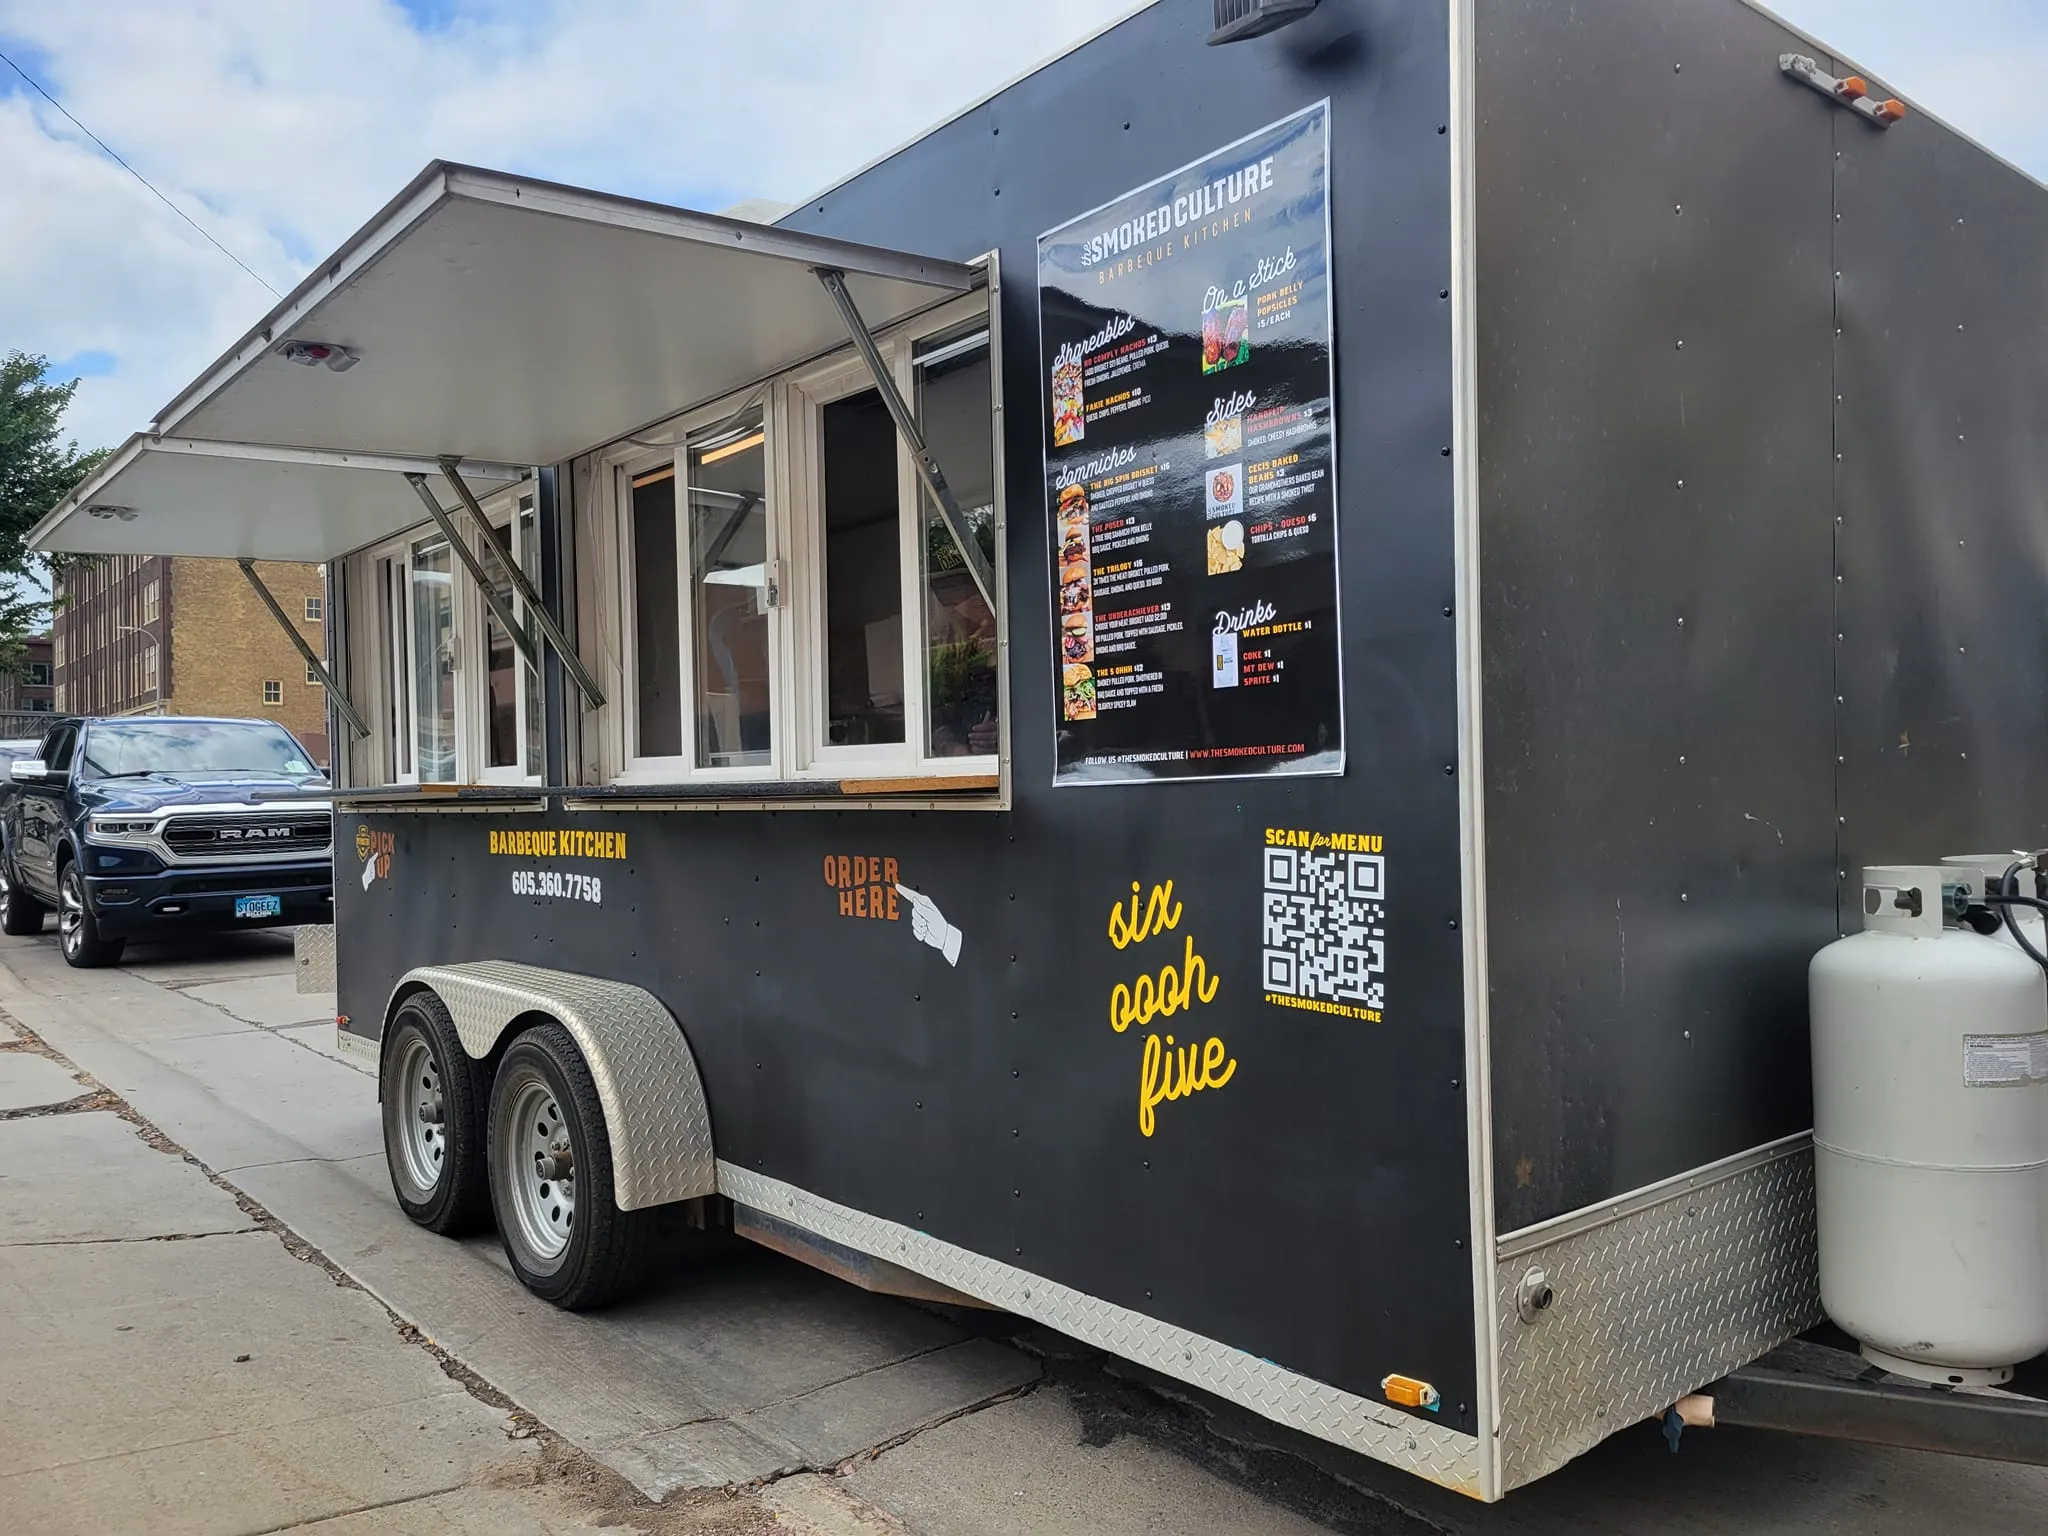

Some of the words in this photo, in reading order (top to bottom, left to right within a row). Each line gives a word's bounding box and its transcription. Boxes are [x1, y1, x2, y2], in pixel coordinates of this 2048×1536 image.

[1091, 205, 1171, 263] SMOKED
[1174, 156, 1274, 228] CULTURE
[1099, 241, 1173, 285] BARBEQUE
[1184, 207, 1251, 249] KITCHEN
[1201, 285, 1228, 315] On
[1233, 279, 1246, 298] a
[1248, 245, 1297, 291] Stick
[1256, 290, 1277, 306] PORK
[1279, 280, 1304, 297] BELLY
[1256, 295, 1298, 318] POPSICLES
[1256, 309, 1291, 329] $5/EACH
[1054, 314, 1136, 368] Shareables
[1120, 338, 1146, 354] NACHOS
[1105, 391, 1131, 406] NACHOS
[1206, 389, 1257, 427] Sides
[1247, 411, 1302, 433] HASHBROWNS
[1055, 445, 1137, 490] Sammiches
[1271, 453, 1299, 468] BAKED
[1090, 481, 1102, 490] THE
[1103, 479, 1113, 487] BIG
[1115, 473, 1130, 483] SPIN
[1131, 465, 1159, 479] BRISKET
[1248, 471, 1274, 485] BEANS
[1275, 468, 1285, 477] $3
[1295, 471, 1311, 483] BAKED
[1092, 524, 1103, 534] THE
[1249, 521, 1273, 535] CHIPS
[1280, 515, 1306, 529] QUESO
[1251, 531, 1273, 544] TORTILLA
[1273, 529, 1288, 541] CHIPS
[1293, 524, 1309, 537] QUESO
[1093, 567, 1105, 576] THE
[1106, 561, 1132, 573] TRILOGY
[1095, 614, 1106, 622] THE
[1108, 604, 1160, 620] UNDERACHIEVER
[1212, 599, 1277, 636] Drinks
[1242, 625, 1271, 639] WATER
[1272, 621, 1302, 634] BOTTLE
[1242, 650, 1262, 661] COKE
[1263, 649, 1271, 658] $1
[1243, 664, 1255, 673] MT
[1257, 661, 1275, 671] DEW
[1276, 660, 1284, 669] $1
[1096, 669, 1108, 677] THE
[1243, 675, 1271, 686] SPRITE
[1272, 673, 1280, 683] $1
[1085, 756, 1107, 766] FOLLOW
[1108, 755, 1117, 764] US
[1117, 750, 1185, 763] @THESMOKEDCULTURE
[1190, 743, 1305, 760] WWW.THESMOKEDCULTURE.COM
[220, 827, 290, 839] RAM
[370, 830, 395, 857] PICK
[489, 830, 557, 858] BARBEQUE
[559, 830, 627, 859] KITCHEN
[1265, 828, 1310, 847] SCAN
[1310, 832, 1331, 851] for
[1331, 833, 1383, 853] MENU
[376, 854, 390, 879] UP
[824, 855, 899, 888] ORDER
[512, 871, 601, 904] 605.360.7758
[839, 885, 900, 921] HERE
[1109, 879, 1183, 950] six
[1110, 935, 1220, 1033] oooh
[1265, 993, 1382, 1023] @THESMOKEDCULTURE
[1139, 1034, 1237, 1137] five
